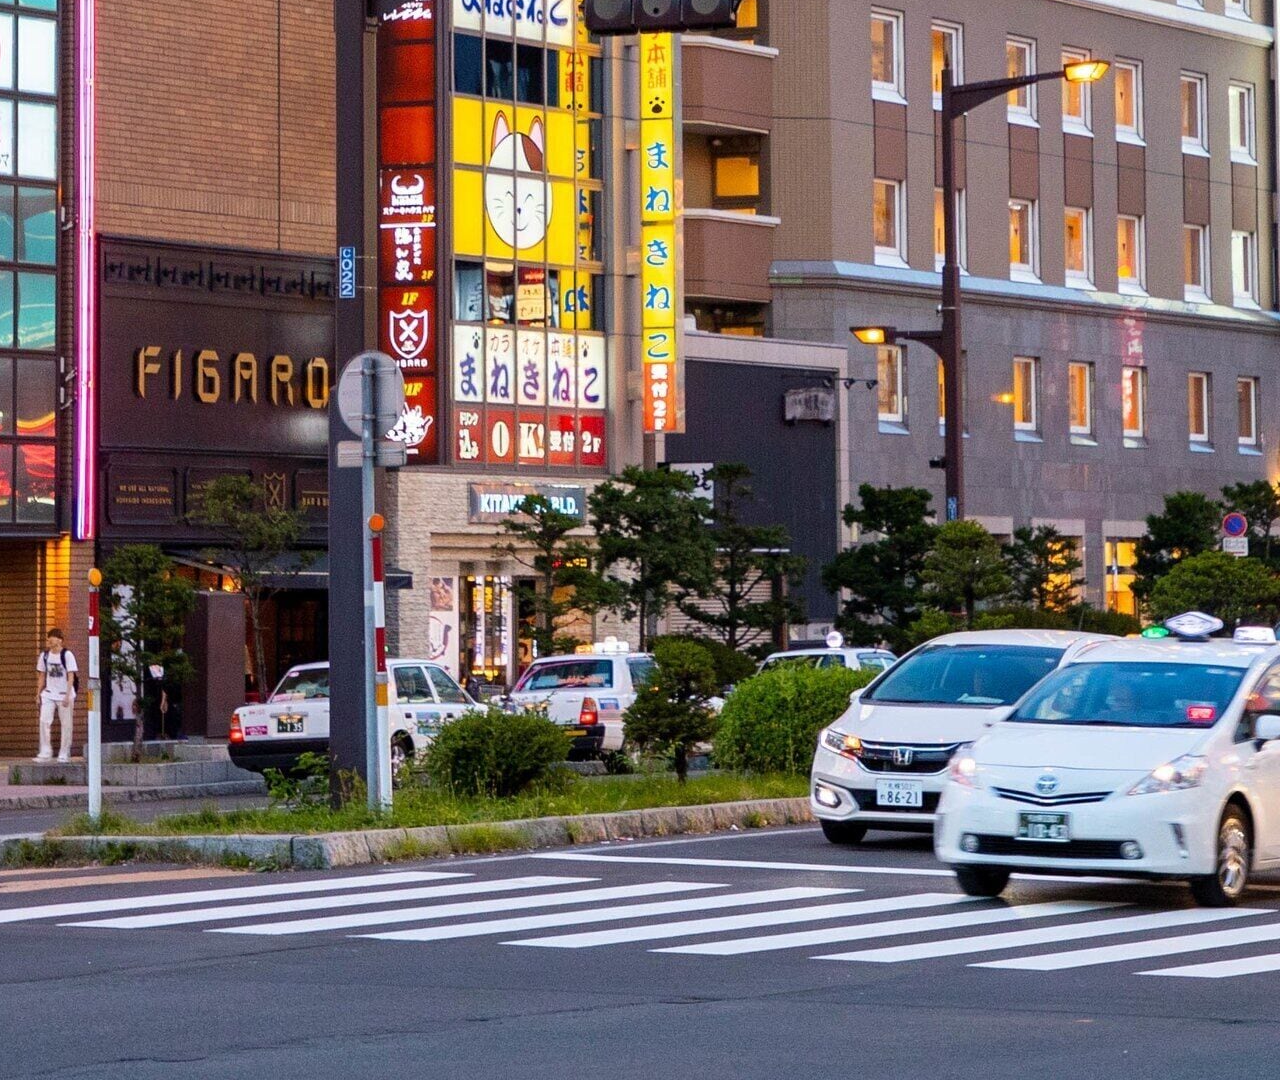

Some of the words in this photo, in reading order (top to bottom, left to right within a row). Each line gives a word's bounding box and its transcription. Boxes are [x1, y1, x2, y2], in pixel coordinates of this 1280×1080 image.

[341, 248, 354, 296] C022
[645, 141, 671, 358] まねきねこ
[400, 292, 419, 306] 1F
[138, 345, 330, 409] FIGARO
[395, 358, 429, 368] IGARO
[458, 352, 600, 404] まねきねこ
[650, 363, 669, 431] 受付2F
[549, 430, 575, 453] 受付
[581, 430, 602, 453] 2F
[886, 790, 919, 805] 86-21
